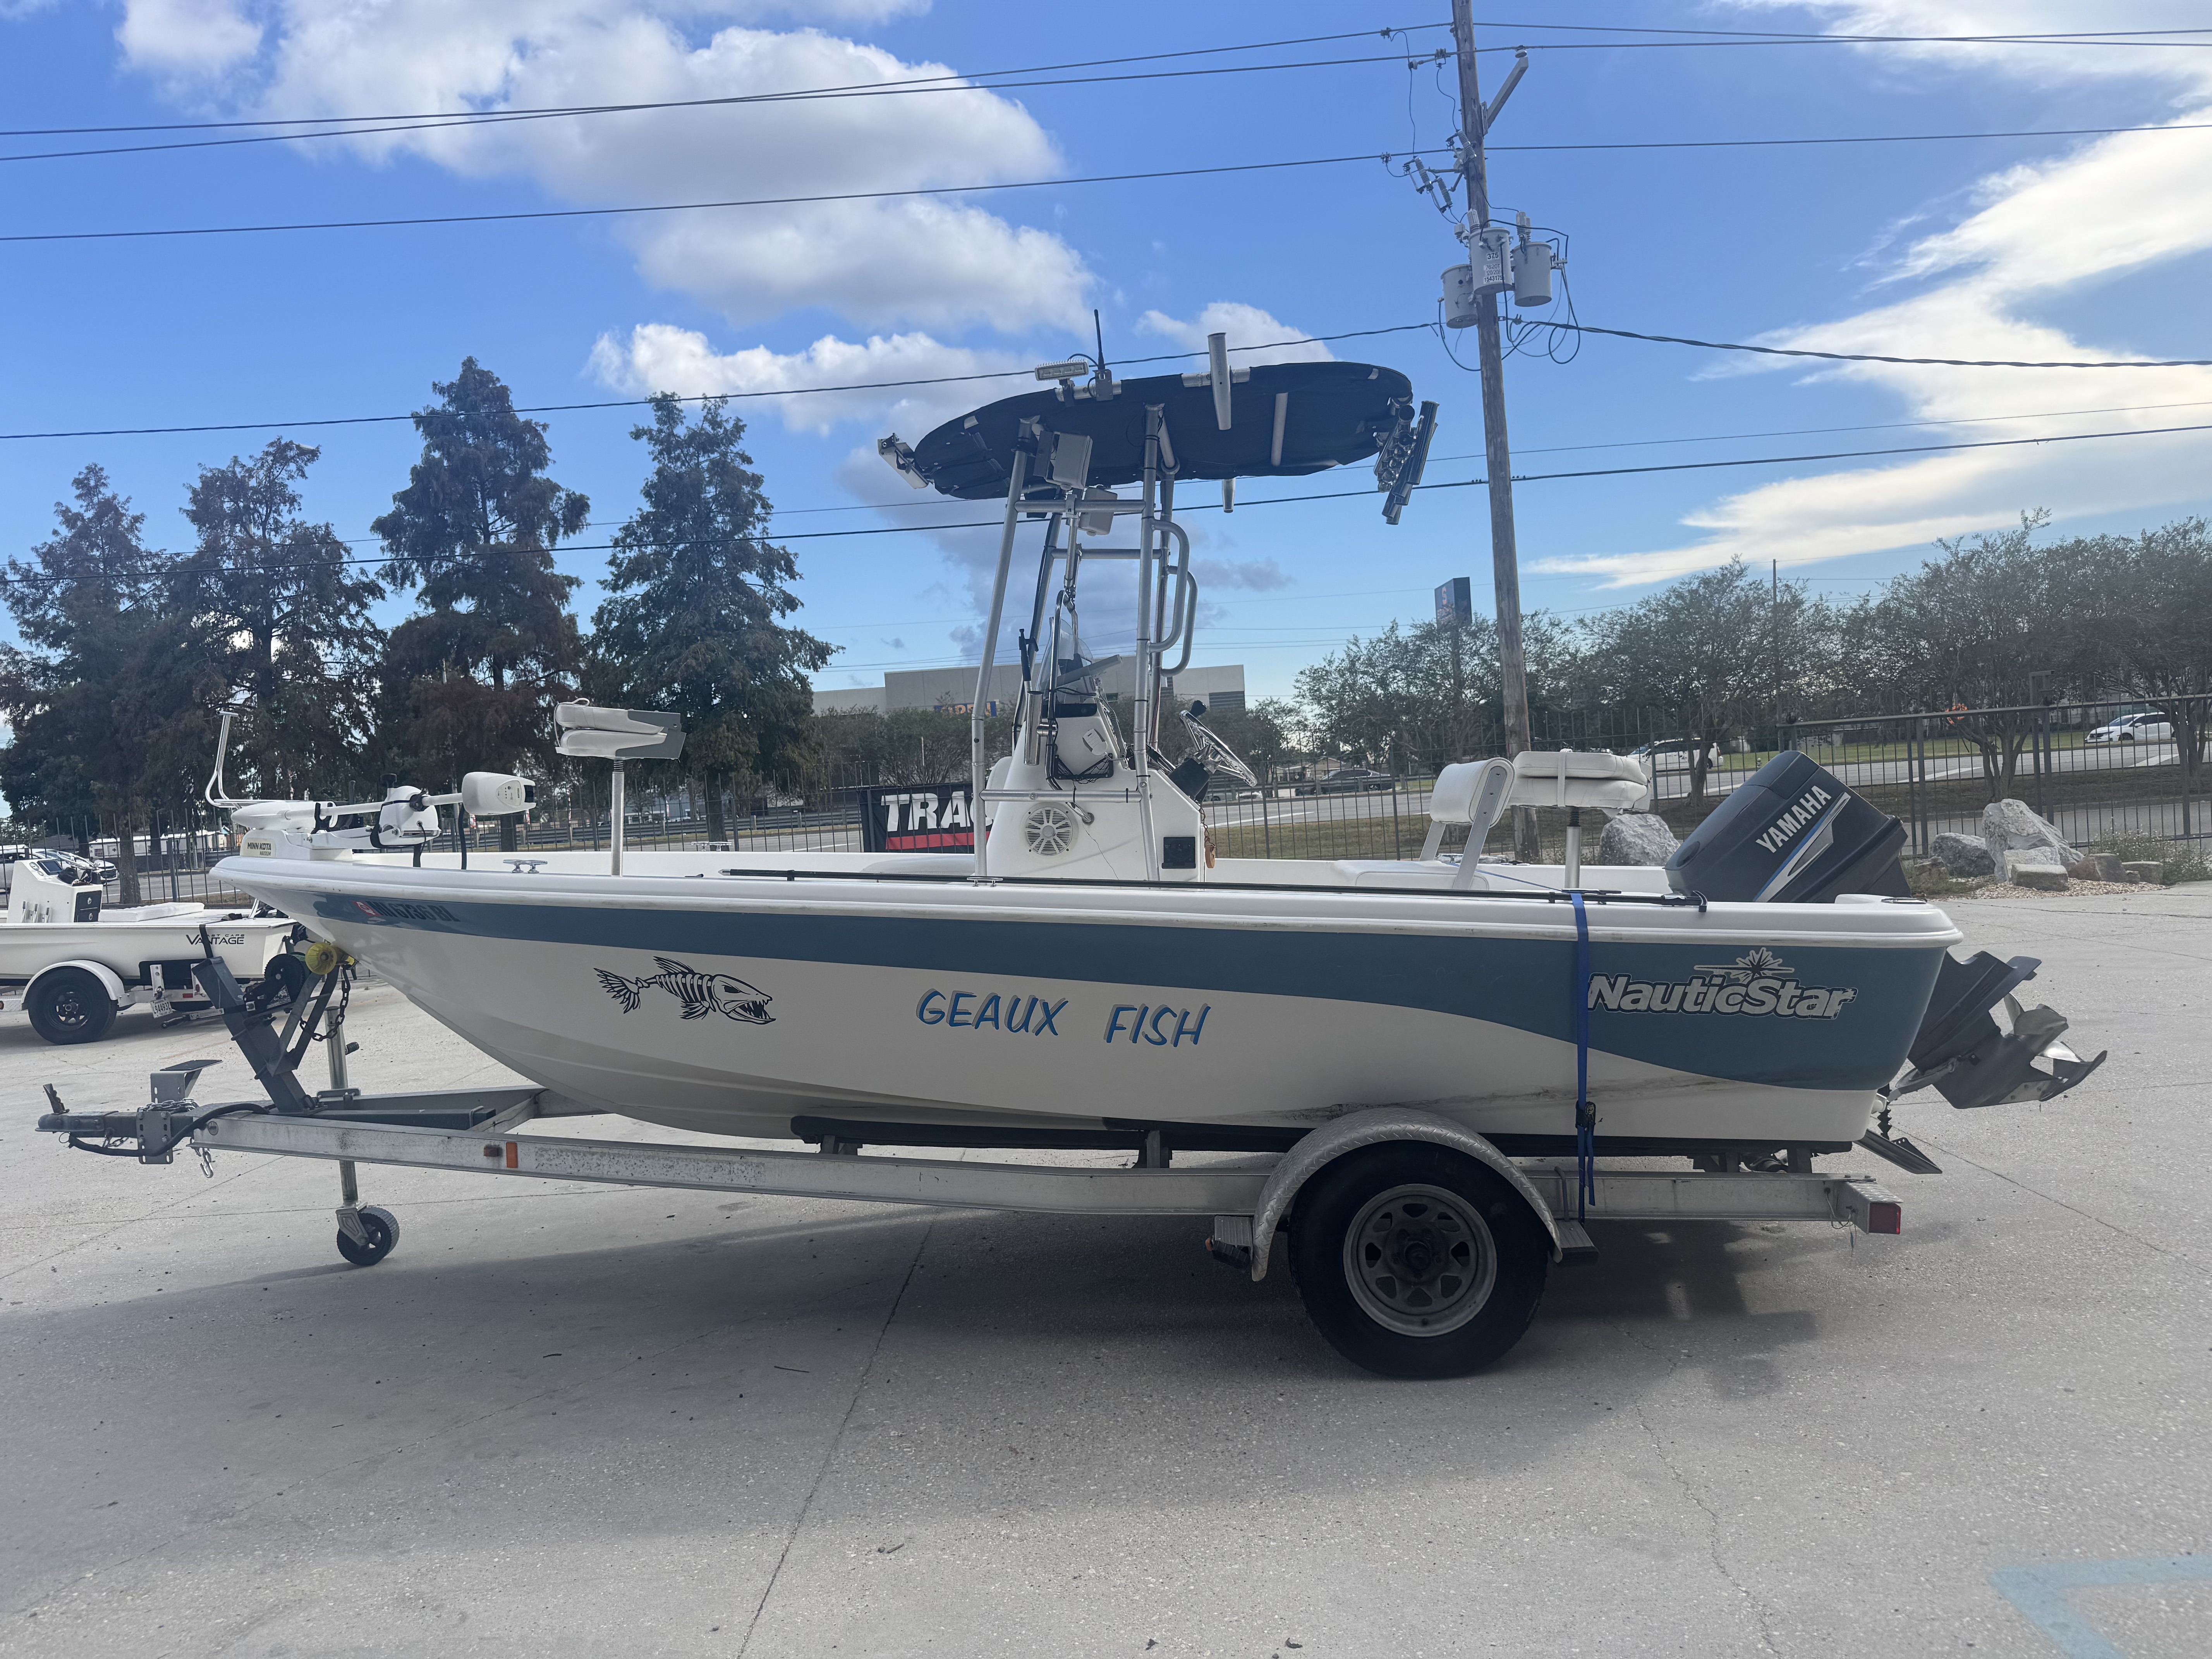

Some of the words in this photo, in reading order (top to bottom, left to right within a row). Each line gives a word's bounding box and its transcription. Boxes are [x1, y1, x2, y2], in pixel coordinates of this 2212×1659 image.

[1755, 785, 1832, 853] YAMAHA
[916, 988, 1069, 1036] GEAUX
[1104, 1003, 1211, 1048] FISH
[1587, 972, 1858, 1020] NauticStar
